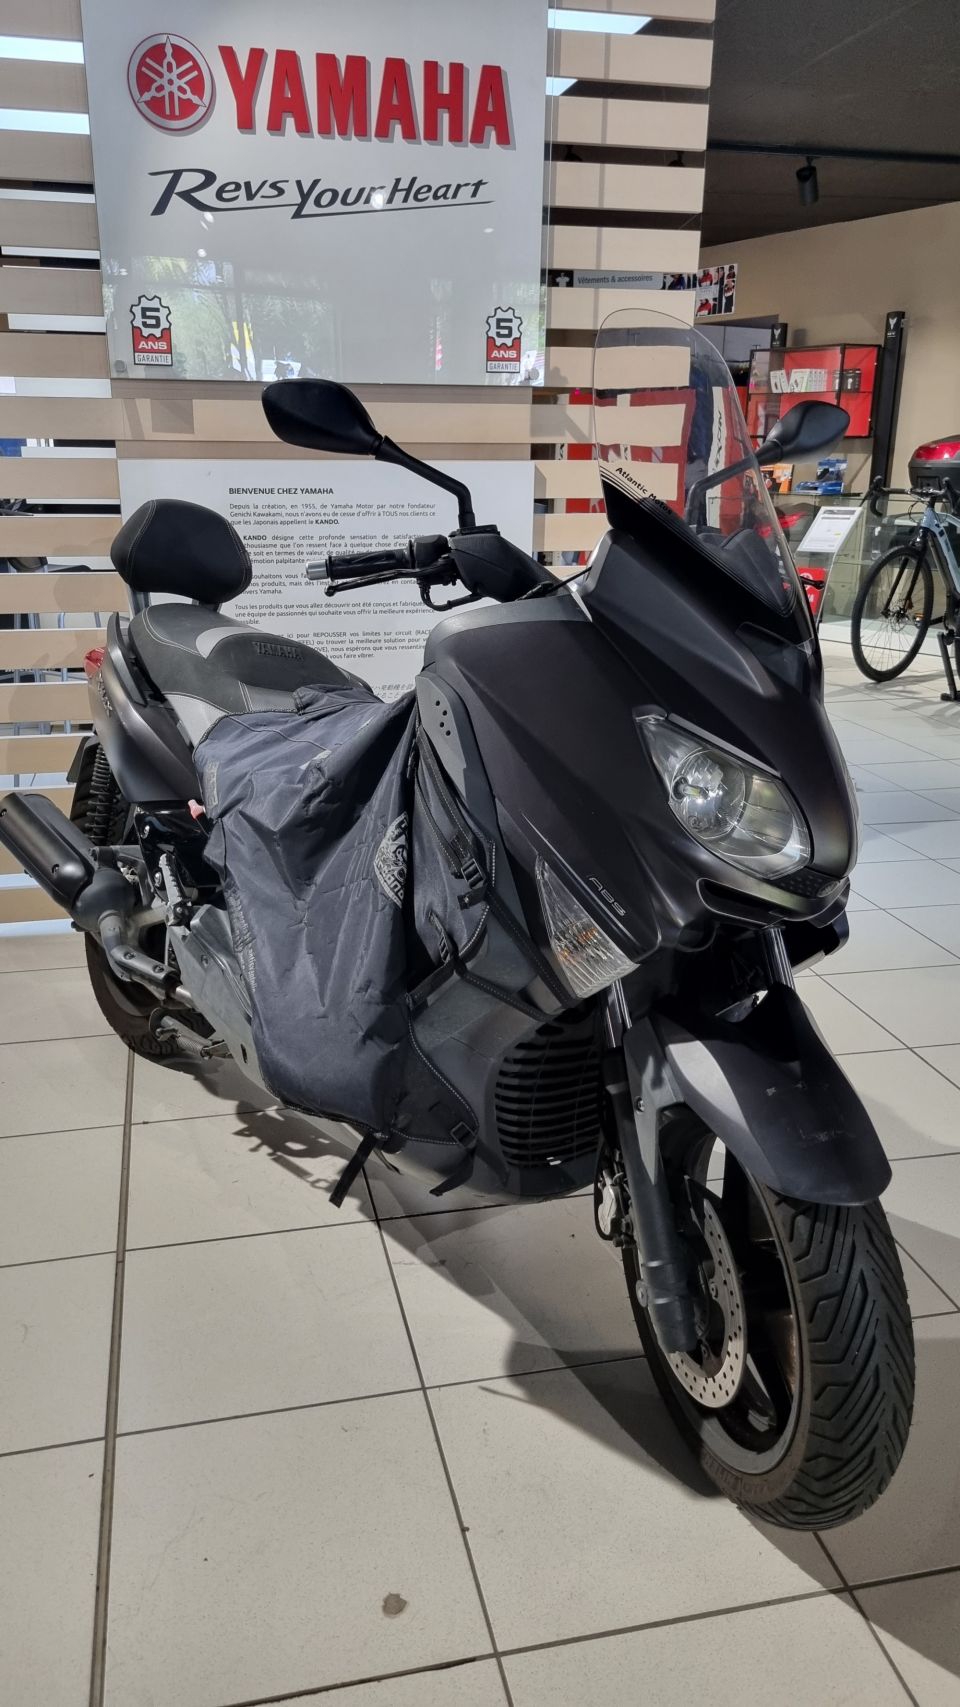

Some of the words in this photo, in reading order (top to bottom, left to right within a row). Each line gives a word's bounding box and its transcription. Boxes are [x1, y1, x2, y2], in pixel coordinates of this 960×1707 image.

[218, 45, 512, 147] YAMAHA
[148, 168, 290, 217] Revs
[291, 177, 387, 220] Your
[386, 176, 492, 206] Heart
[610, 275, 616, 283] &
[617, 275, 653, 283] accessoires
[140, 306, 161, 329] 5
[495, 317, 513, 339] 5
[138, 341, 168, 350] ANS
[136, 353, 170, 364] GARANTIE
[490, 350, 518, 359] ANS
[488, 362, 518, 371] GARANTIE
[615, 467, 648, 495] Atlantic
[228, 487, 275, 495] BIENVENUE
[277, 487, 298, 495] CHEZ
[300, 487, 334, 495] YAMAHA
[229, 503, 250, 511] Depuis
[261, 502, 288, 511] création,
[301, 503, 317, 511] 1955,
[252, 510, 285, 518] Kawakami,
[279, 519, 307, 527] appellent
[271, 534, 295, 542] désigne
[318, 534, 346, 542] profonde
[258, 603, 283, 611] produits
[252, 641, 304, 661] YAMAHA
[588, 877, 627, 917] ABS
